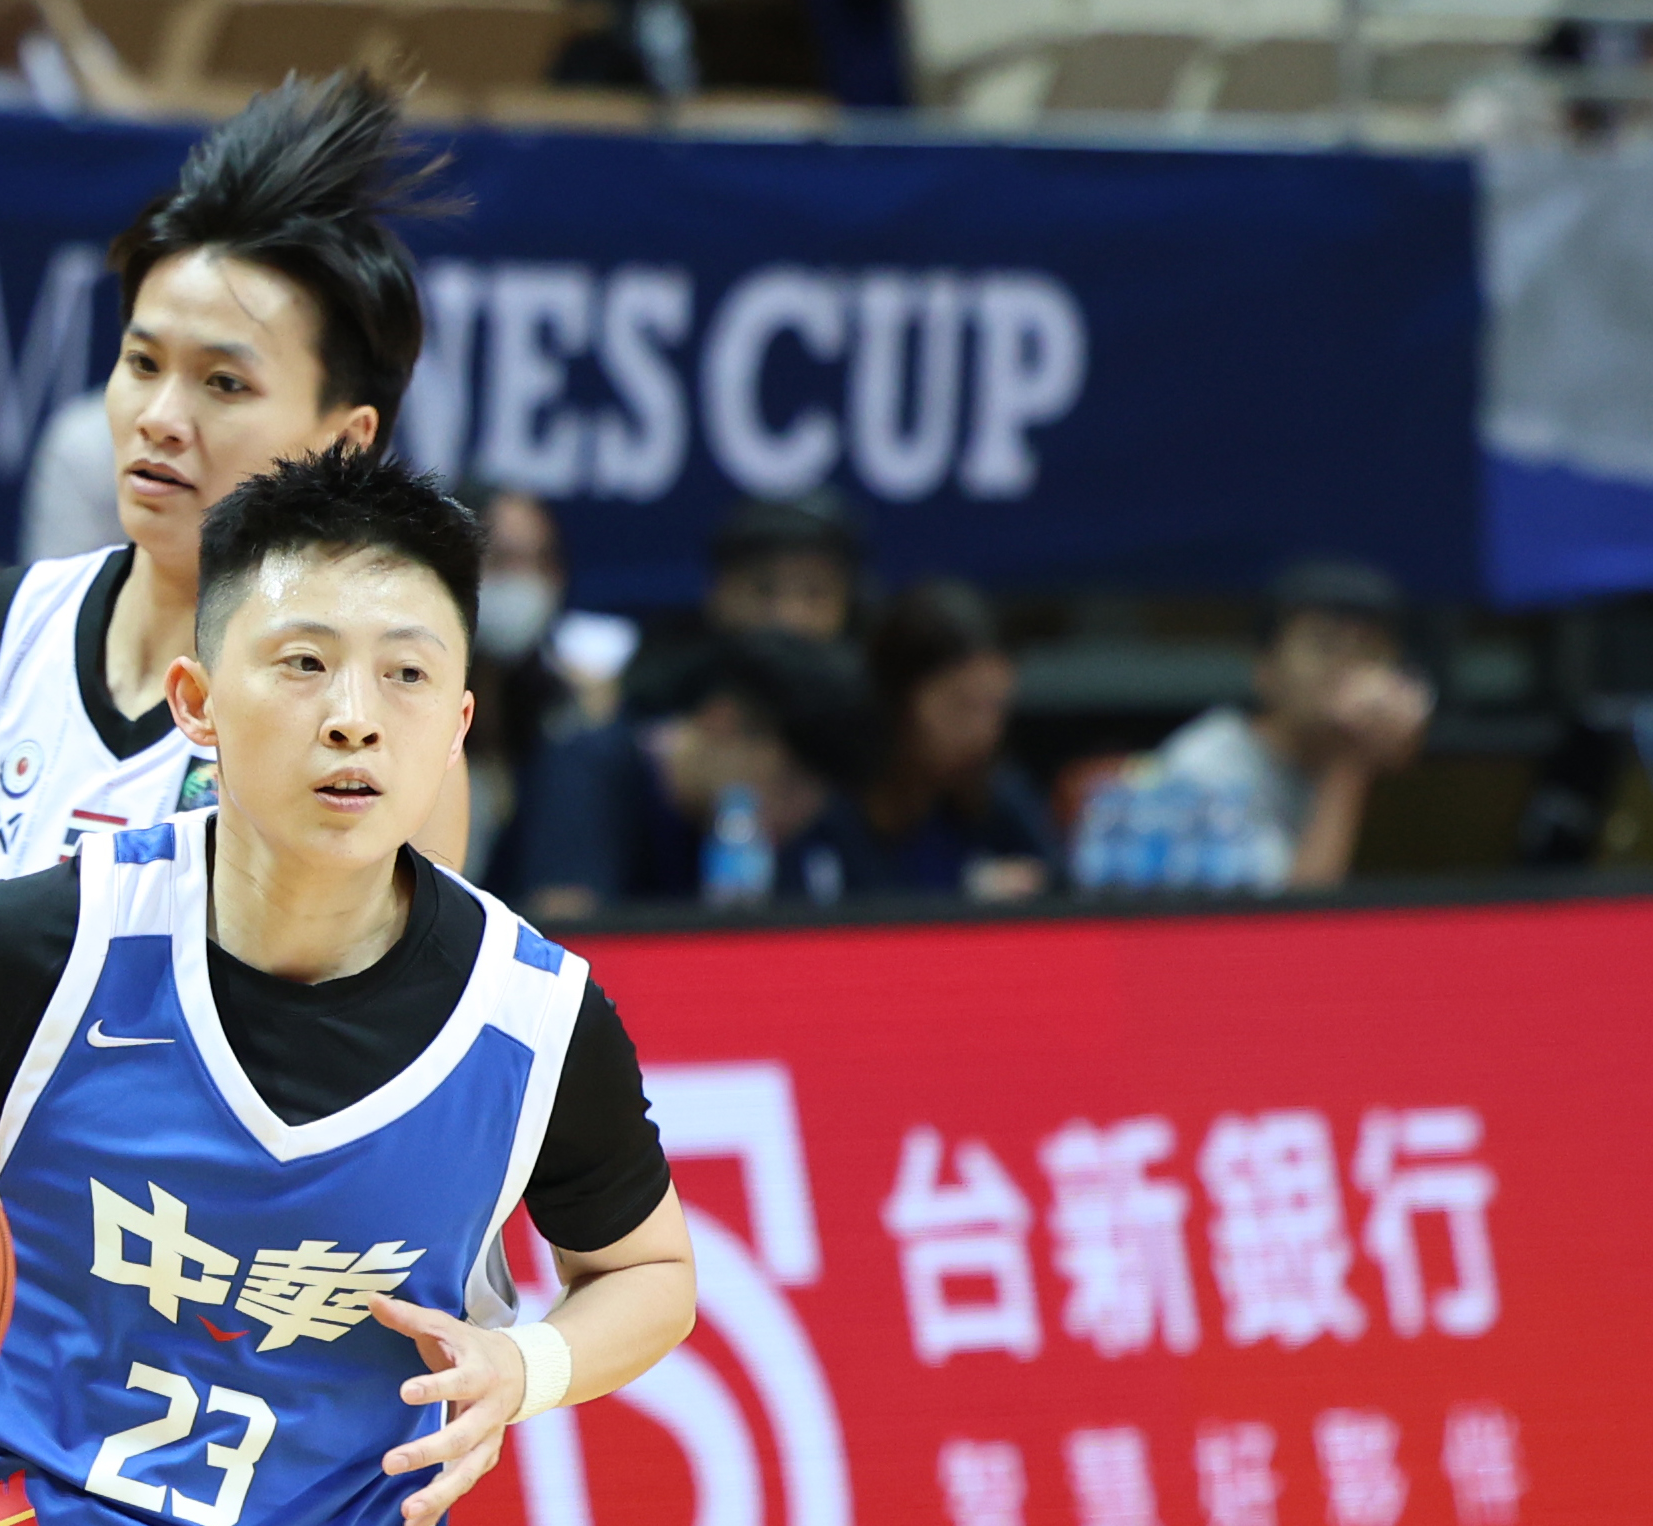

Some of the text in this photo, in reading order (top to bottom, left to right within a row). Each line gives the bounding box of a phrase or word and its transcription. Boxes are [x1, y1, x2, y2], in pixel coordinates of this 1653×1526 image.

[387, 258, 695, 500] NES
[701, 262, 1088, 503] CUP
[89, 1177, 427, 1352] 中華
[881, 1108, 1500, 1366] 台新銀行
